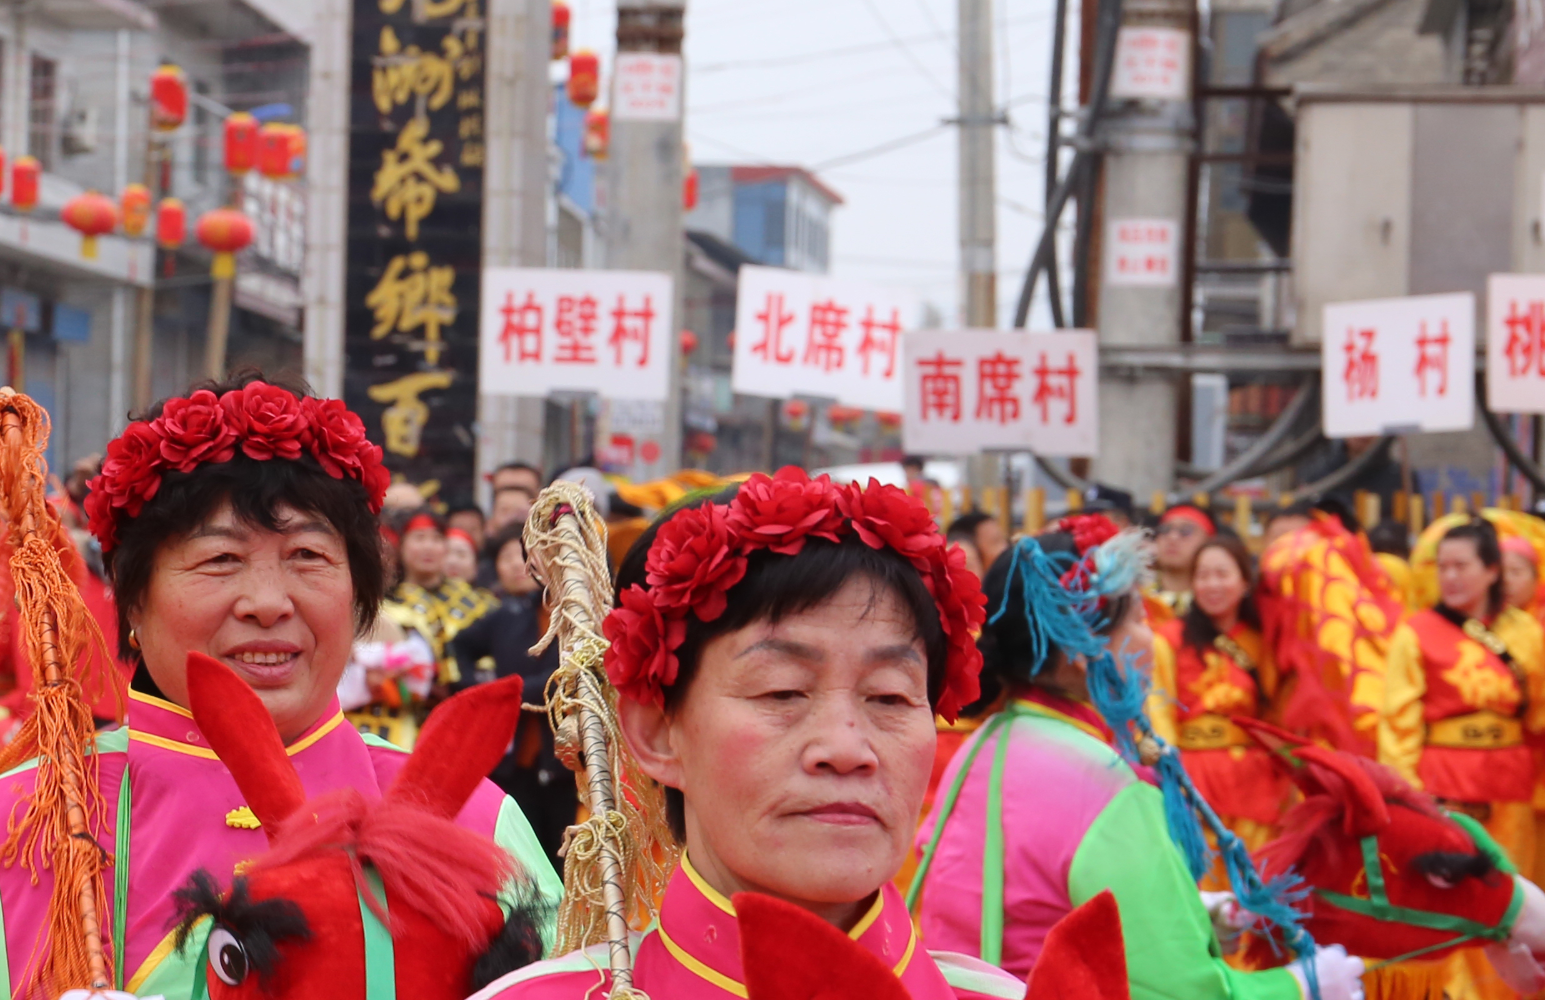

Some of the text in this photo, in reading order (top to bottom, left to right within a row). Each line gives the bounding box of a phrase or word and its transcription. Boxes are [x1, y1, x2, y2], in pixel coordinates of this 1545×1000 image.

[498, 291, 657, 368] 柏壁村
[752, 291, 902, 379] 北席村
[1342, 320, 1453, 404] 杨村
[915, 351, 1082, 426] 南席村
